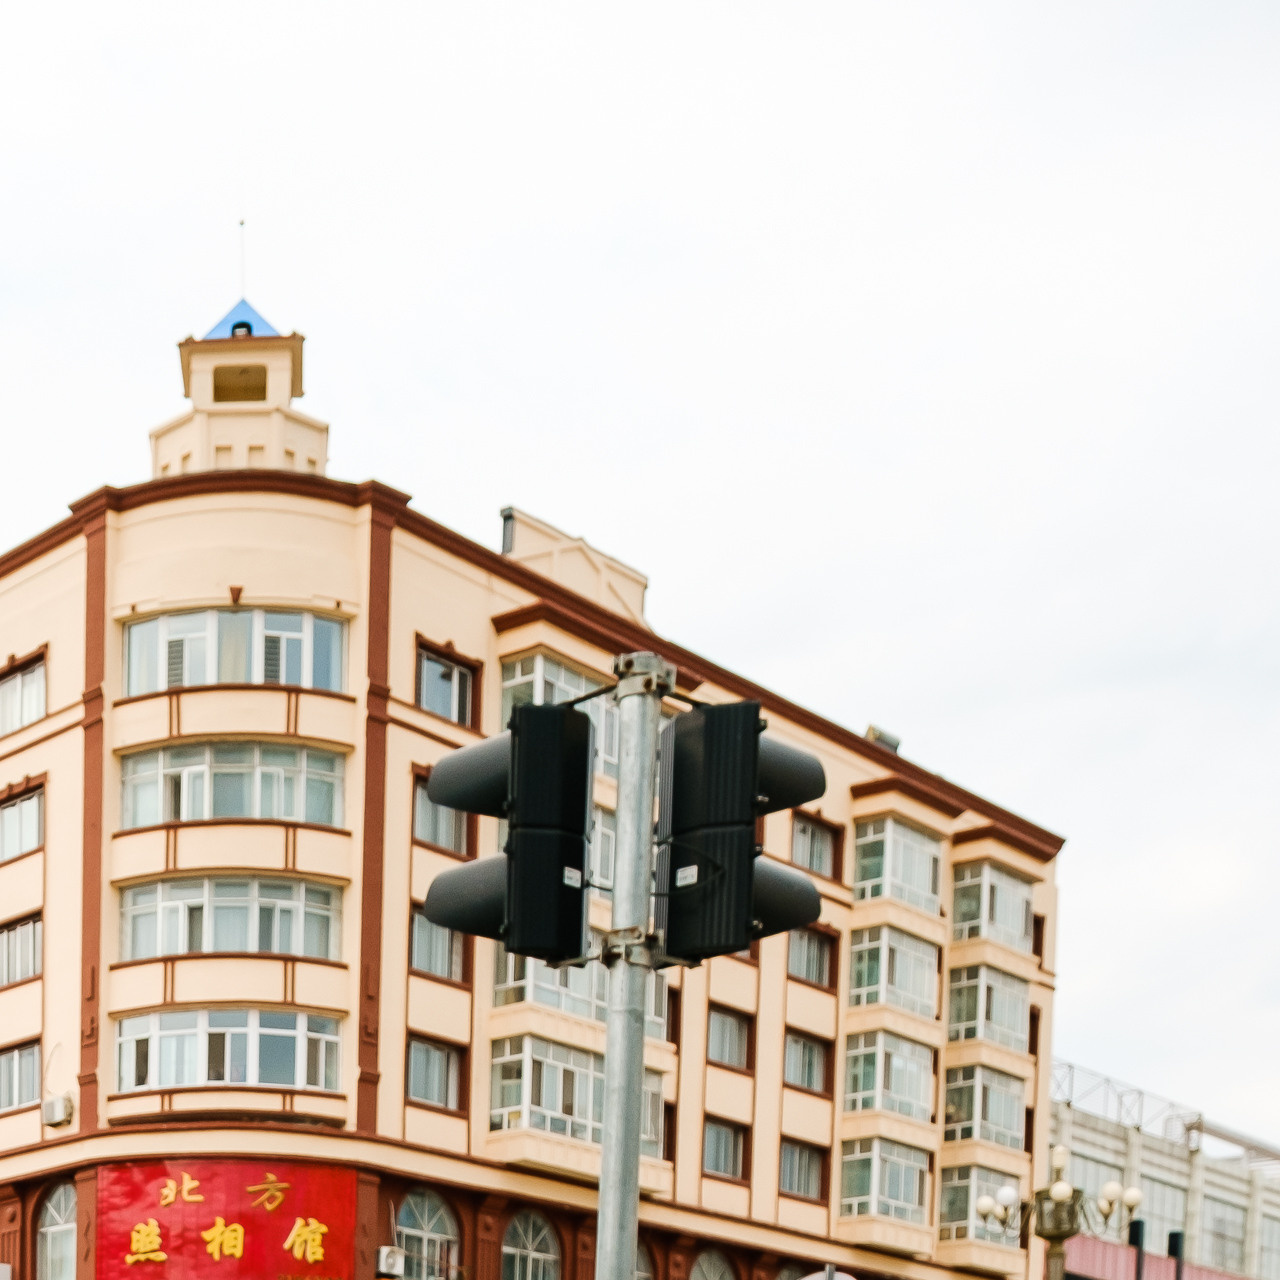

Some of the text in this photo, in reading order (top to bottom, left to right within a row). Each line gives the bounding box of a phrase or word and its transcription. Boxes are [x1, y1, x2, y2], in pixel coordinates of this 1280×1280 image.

[160, 1171, 291, 1212] 北方
[124, 1216, 329, 1265] 照相馆
